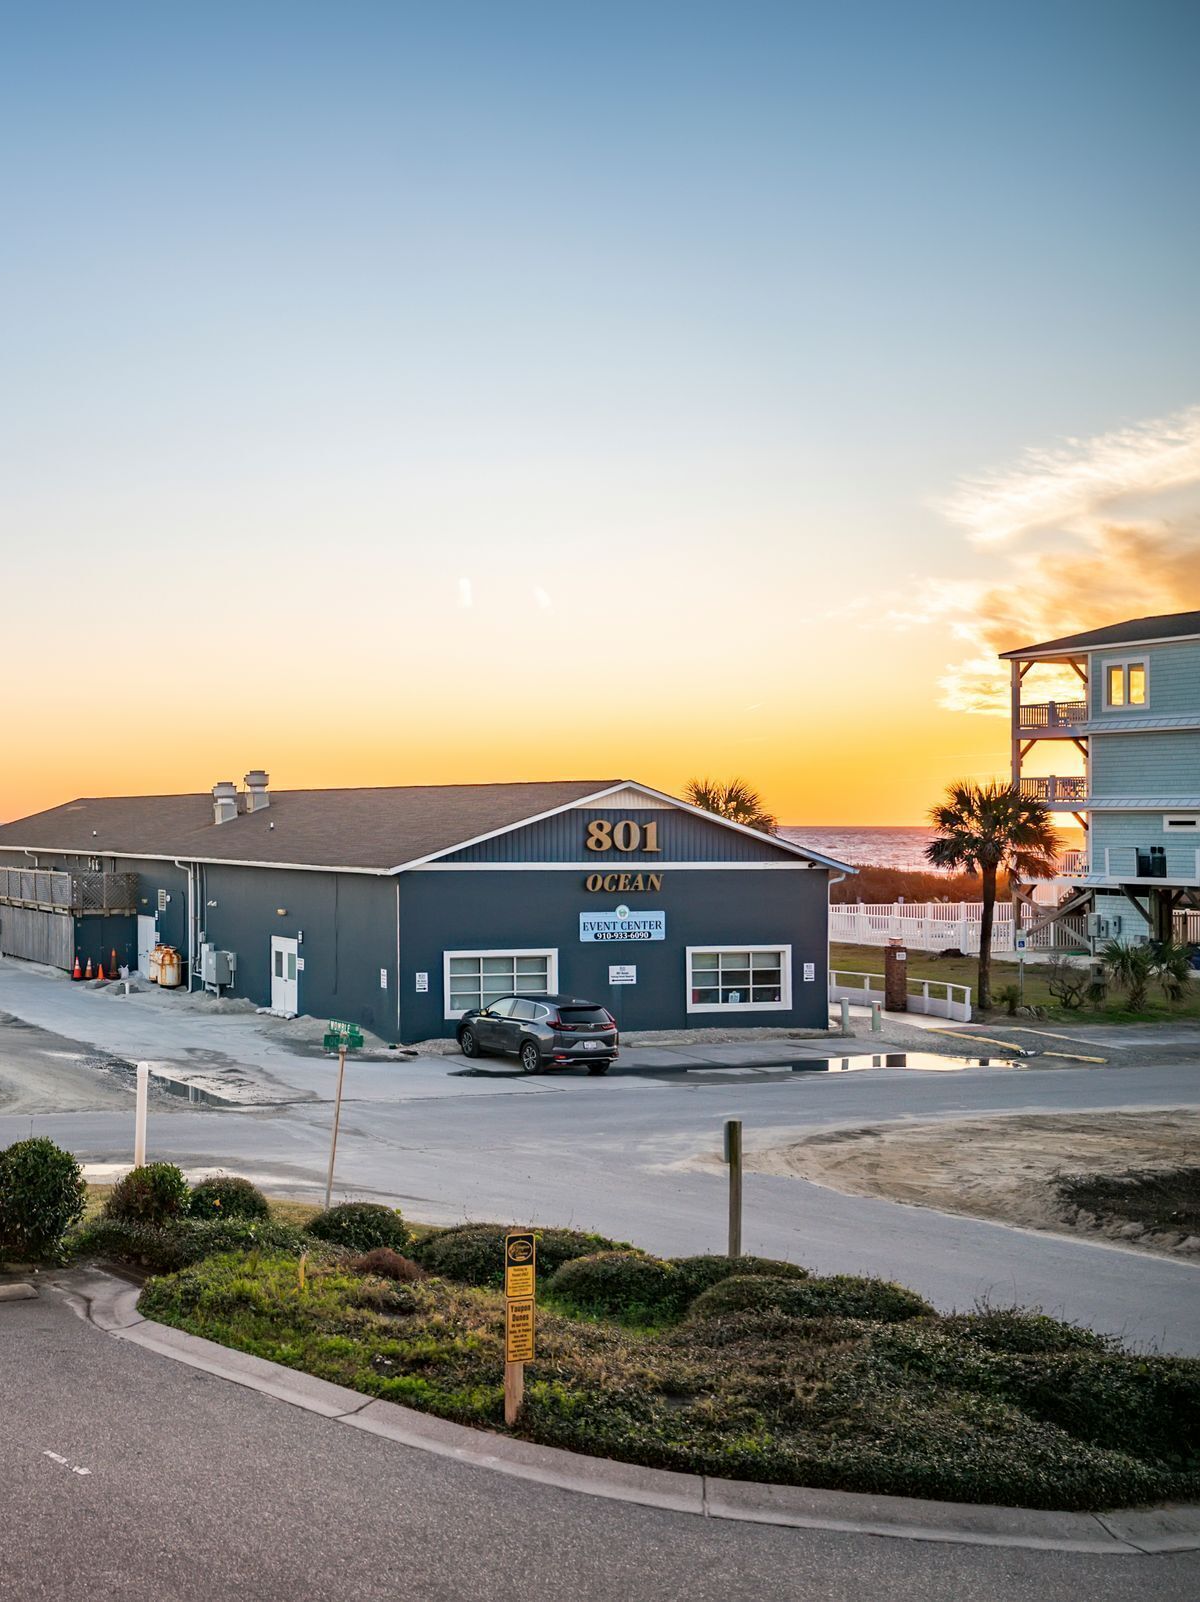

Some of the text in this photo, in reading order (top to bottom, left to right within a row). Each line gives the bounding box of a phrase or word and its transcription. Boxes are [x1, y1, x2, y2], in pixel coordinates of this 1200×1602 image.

[586, 820, 662, 852] 801
[586, 873, 664, 892] OCEAN
[583, 920, 663, 931] EVENT CENTER
[596, 931, 649, 940] 910-933-6090
[511, 1305, 531, 1313] Yaupon
[512, 1314, 529, 1322] Dunes
